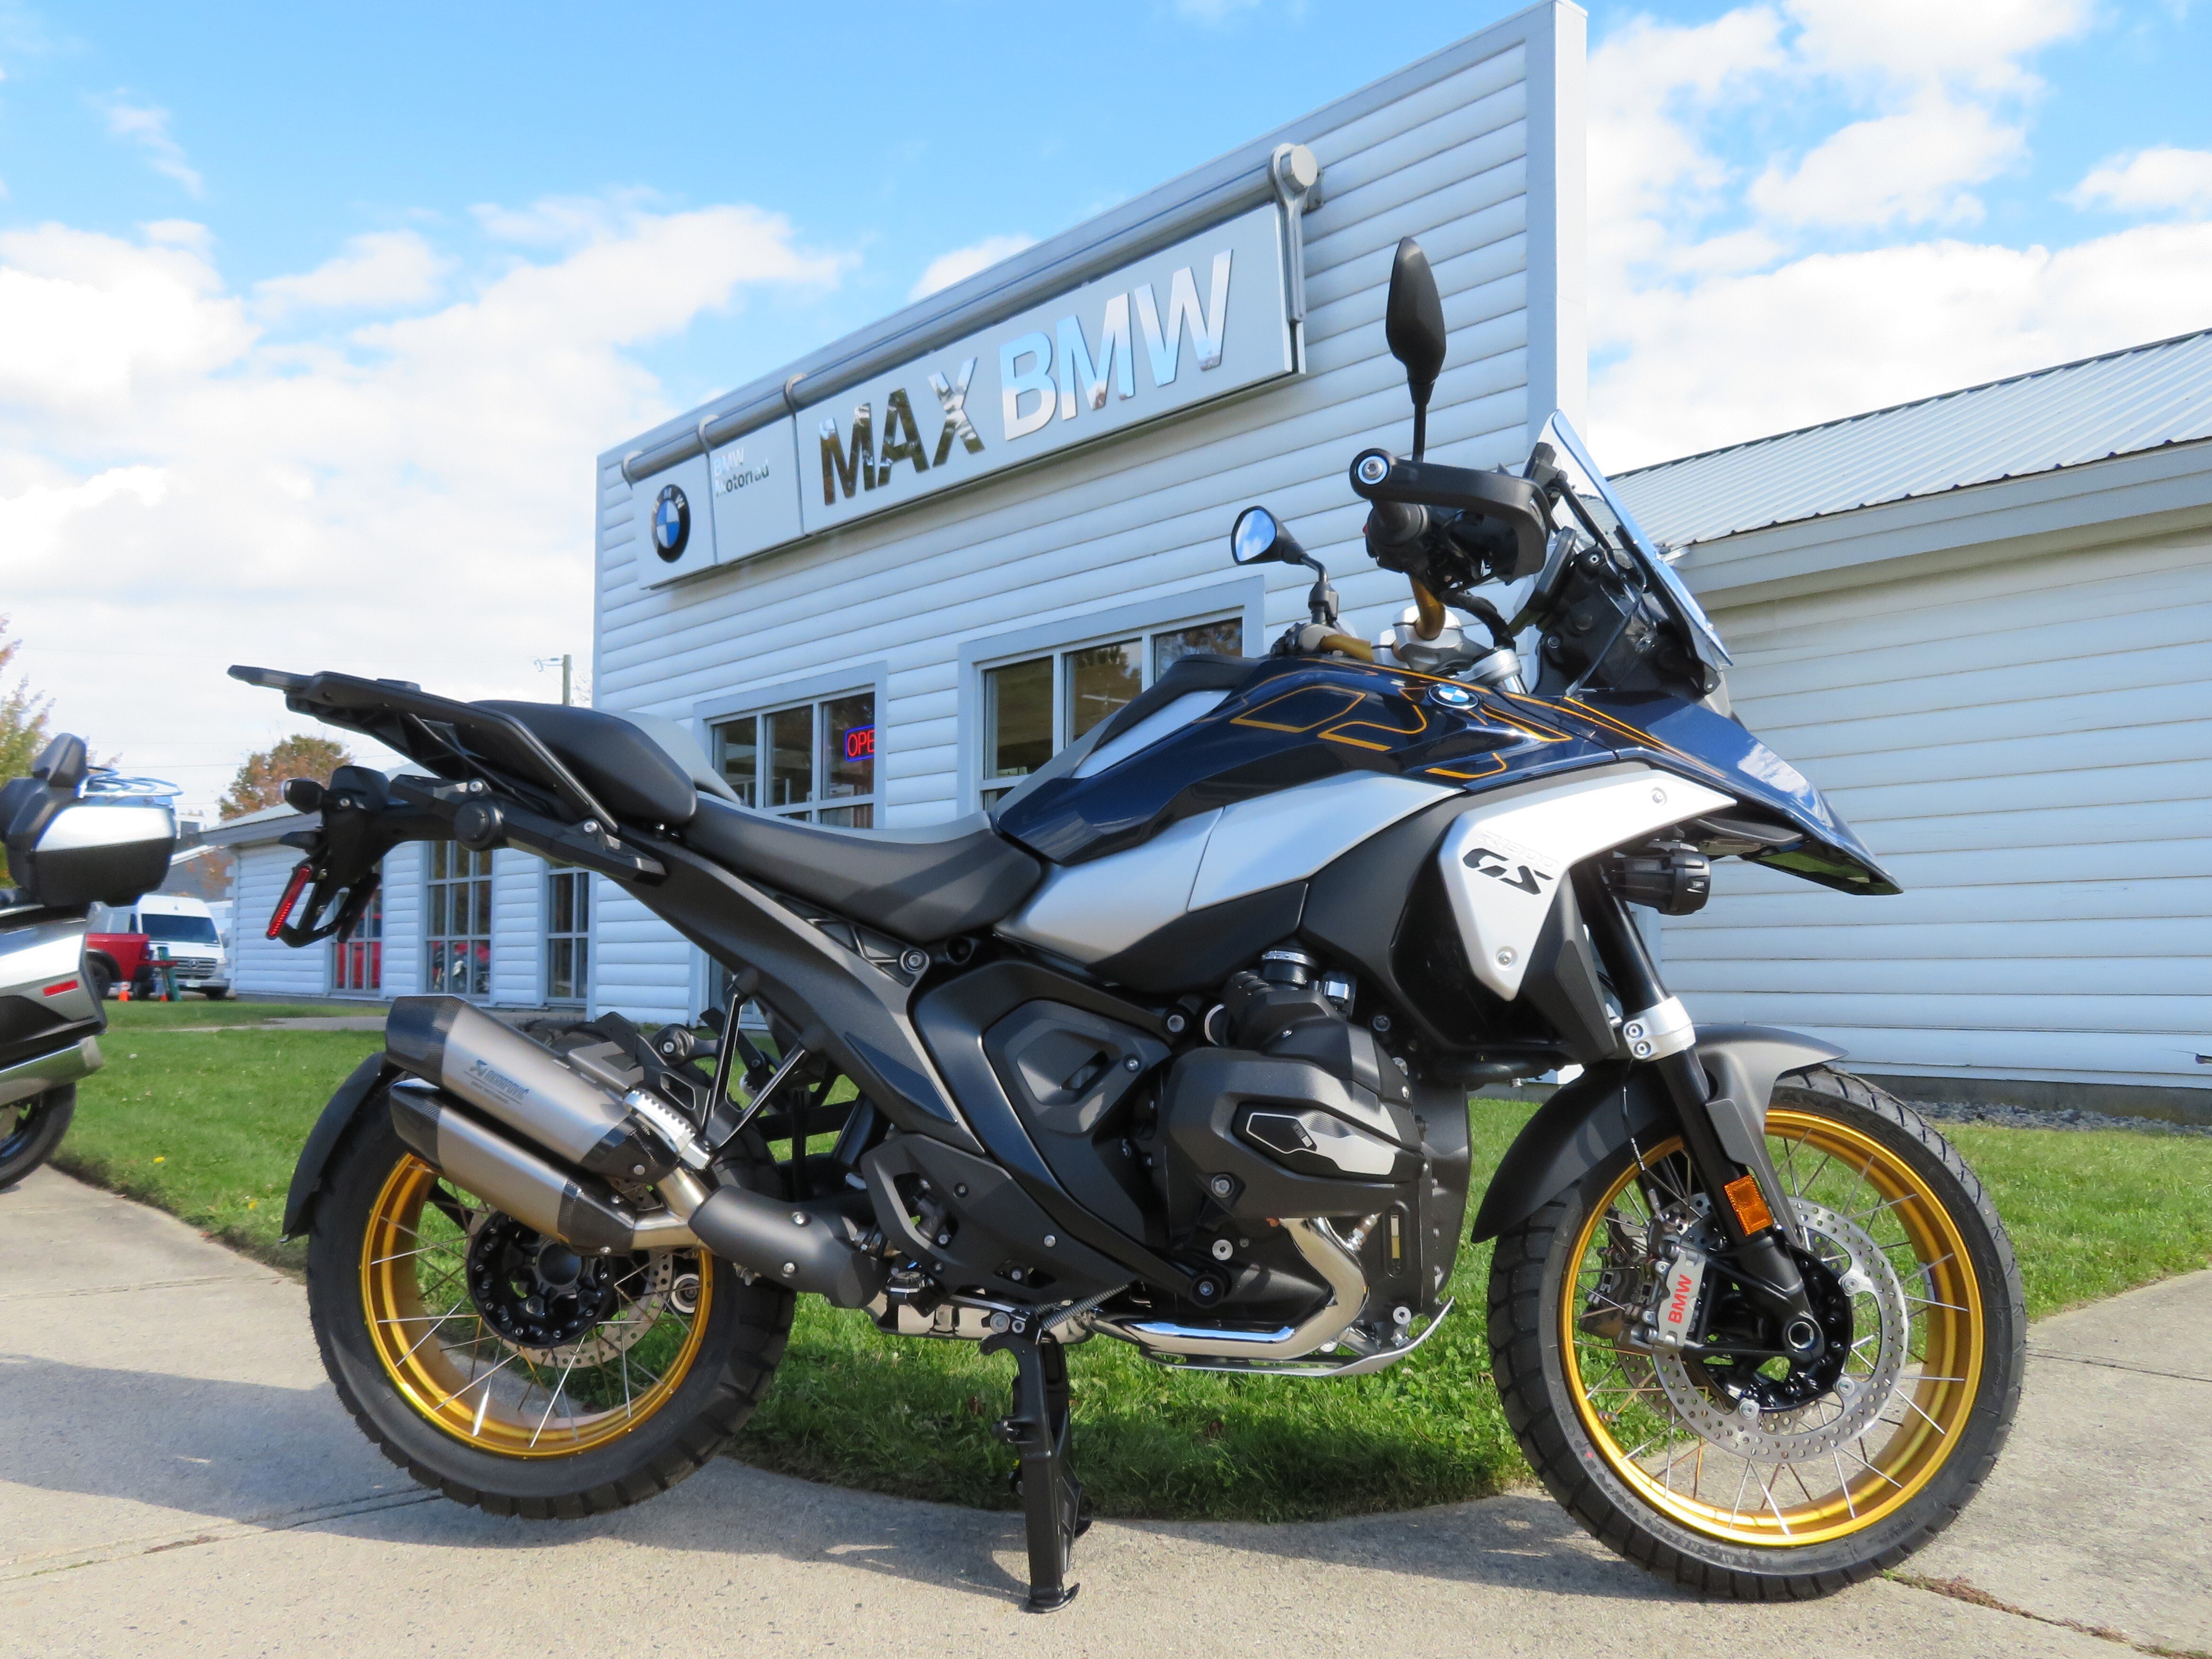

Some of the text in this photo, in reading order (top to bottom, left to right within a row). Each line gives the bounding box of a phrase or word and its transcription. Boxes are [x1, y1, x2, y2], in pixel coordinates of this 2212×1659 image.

[819, 249, 1233, 506] MAX BMW
[714, 447, 745, 476] BMW
[715, 459, 770, 497] Motorrad
[847, 730, 875, 756] OPE
[1462, 847, 1555, 895] GS
[1668, 1274, 1692, 1324] BMW
